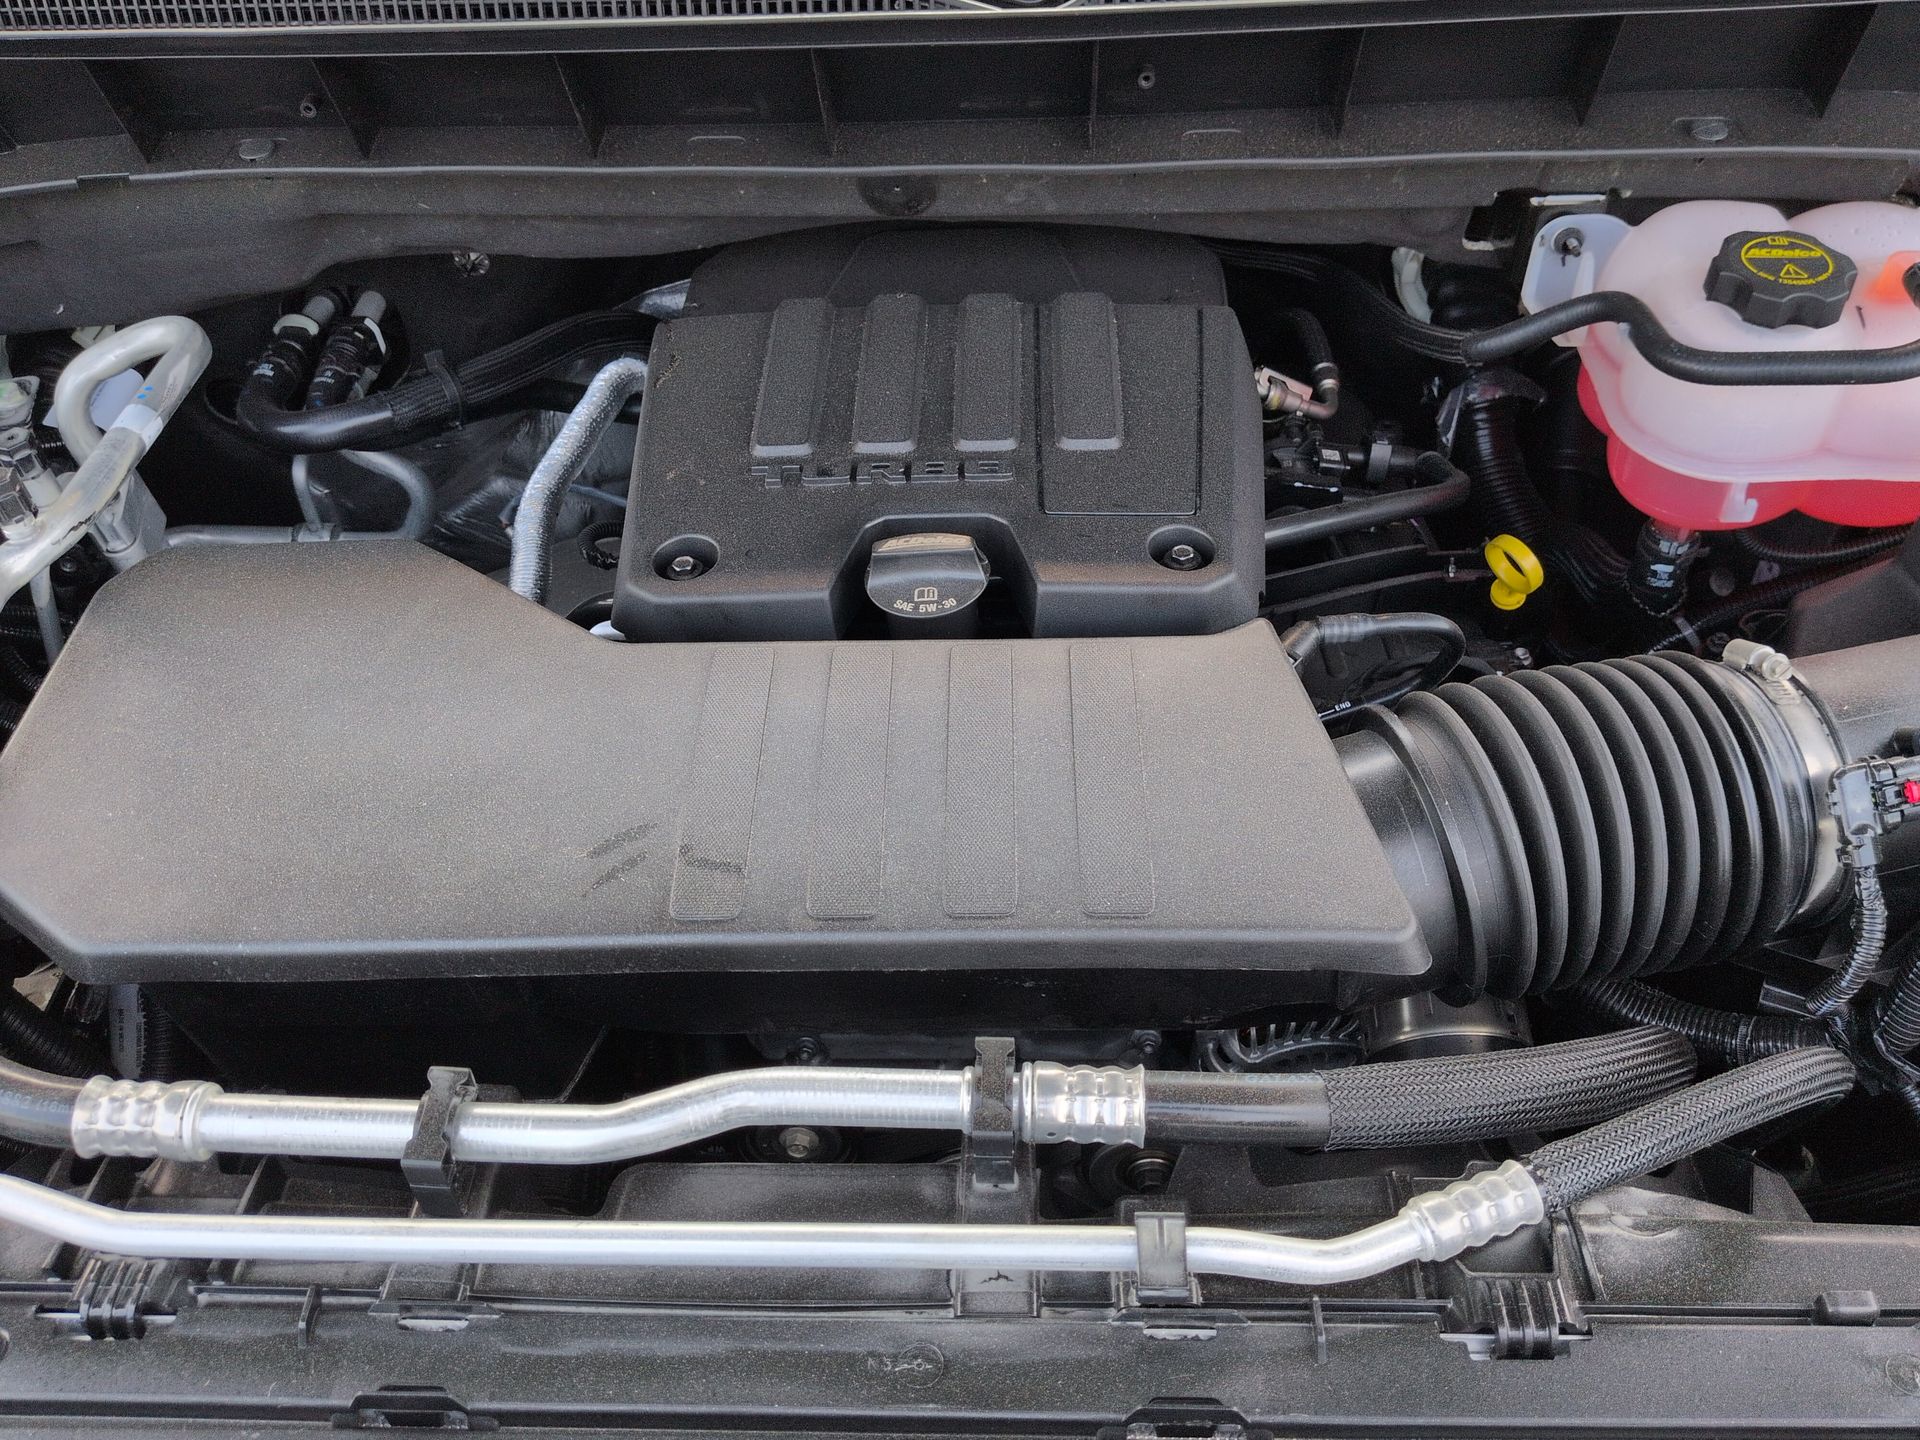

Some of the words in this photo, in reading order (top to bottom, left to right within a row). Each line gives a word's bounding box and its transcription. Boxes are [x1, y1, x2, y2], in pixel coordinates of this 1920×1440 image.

[1745, 247, 1822, 259] ACDelco
[751, 460, 1014, 489] TURBO
[878, 536, 968, 552] ACDelco
[893, 598, 914, 613] SAE
[918, 597, 957, 613] 5W-30
